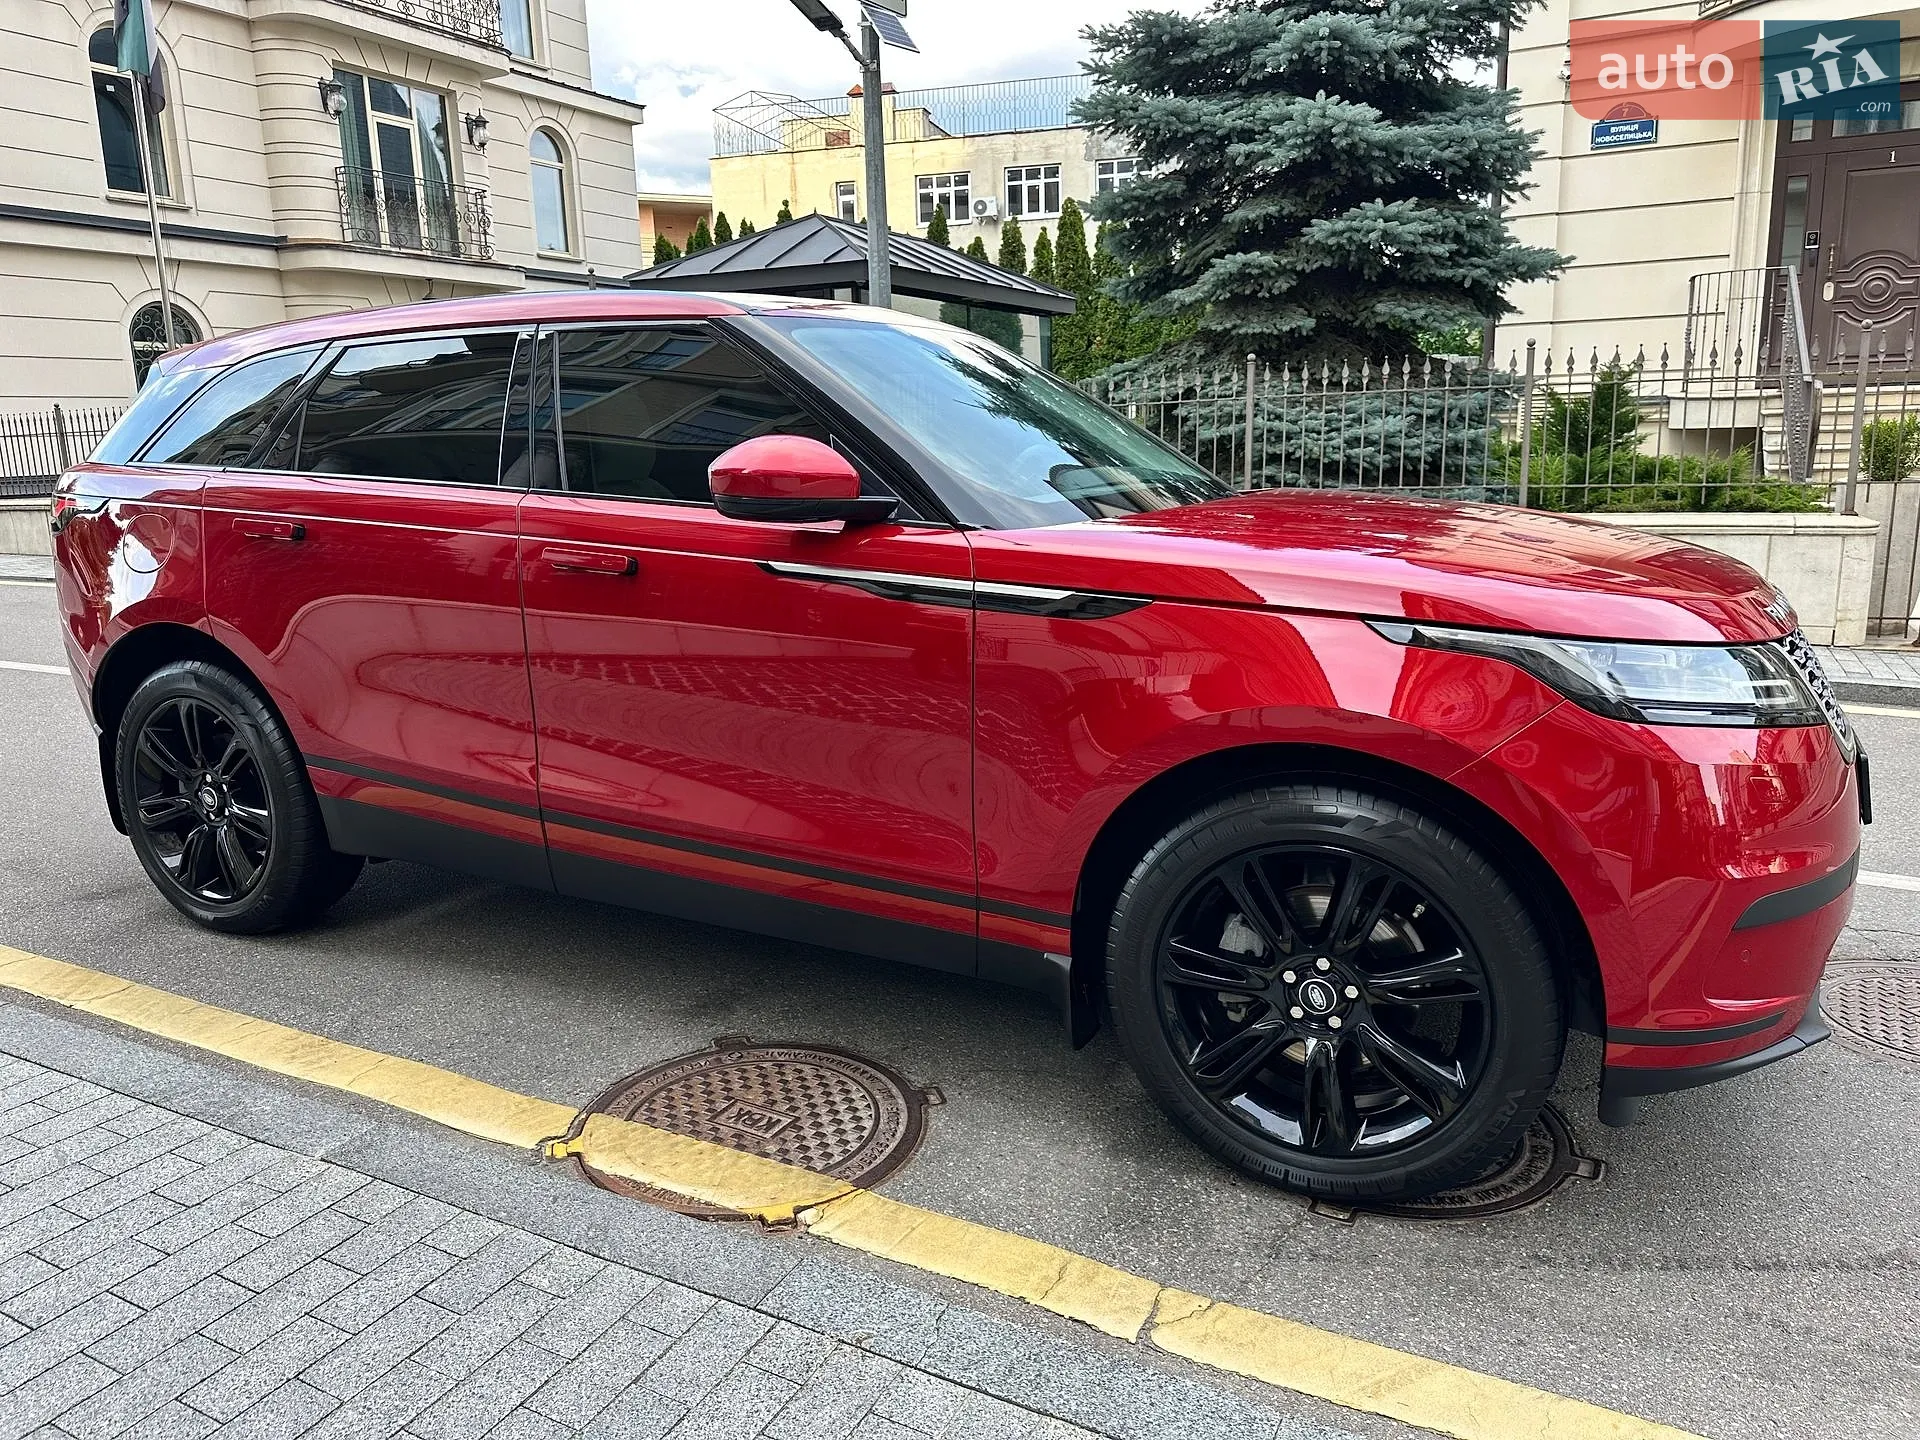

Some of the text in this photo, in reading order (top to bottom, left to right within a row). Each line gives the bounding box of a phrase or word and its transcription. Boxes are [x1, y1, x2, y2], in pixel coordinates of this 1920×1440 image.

[1610, 124, 1639, 133] ВУЛИЦЯ
[1595, 131, 1653, 143] НОВОСЕЛИЦЬКА
[1889, 150, 1896, 163] 1
